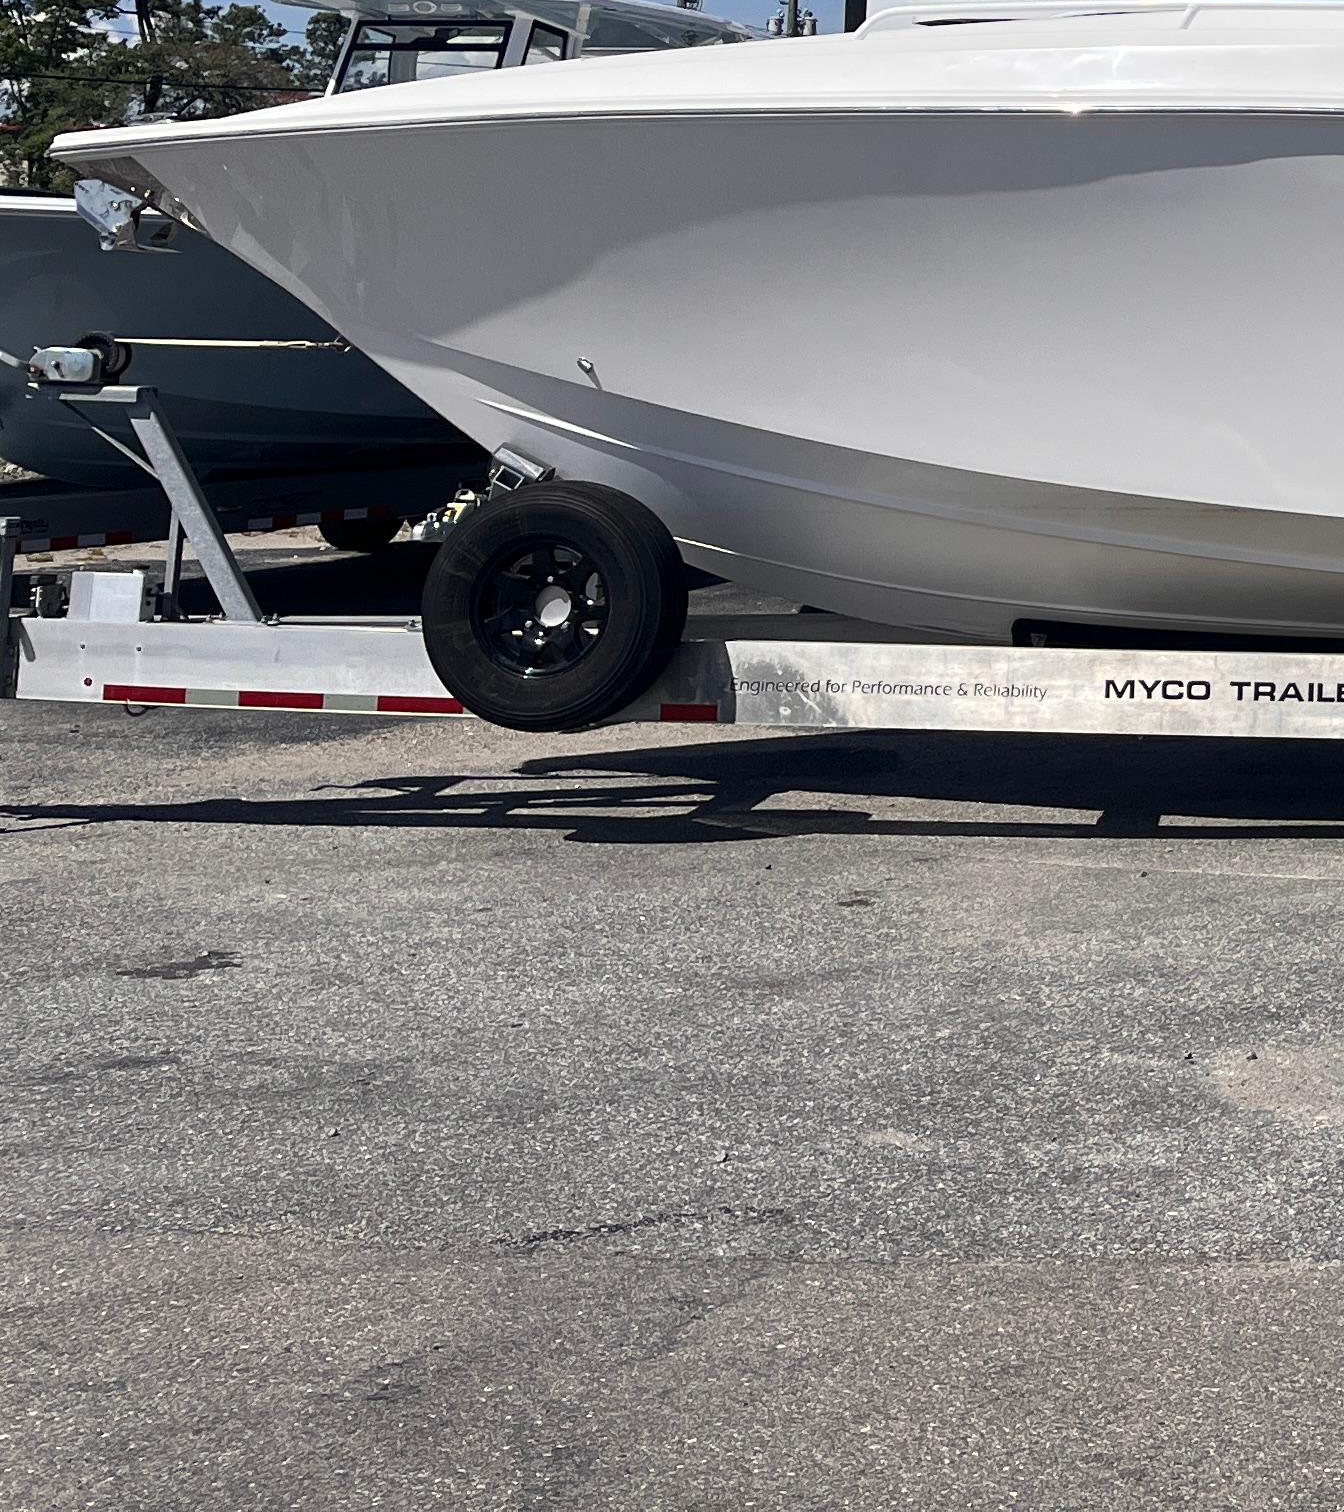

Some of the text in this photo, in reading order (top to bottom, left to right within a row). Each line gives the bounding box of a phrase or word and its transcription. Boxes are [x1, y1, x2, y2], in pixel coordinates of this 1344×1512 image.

[730, 677, 1048, 701] Engineered for Performance & Reliability
[1104, 679, 1211, 700] MYCO
